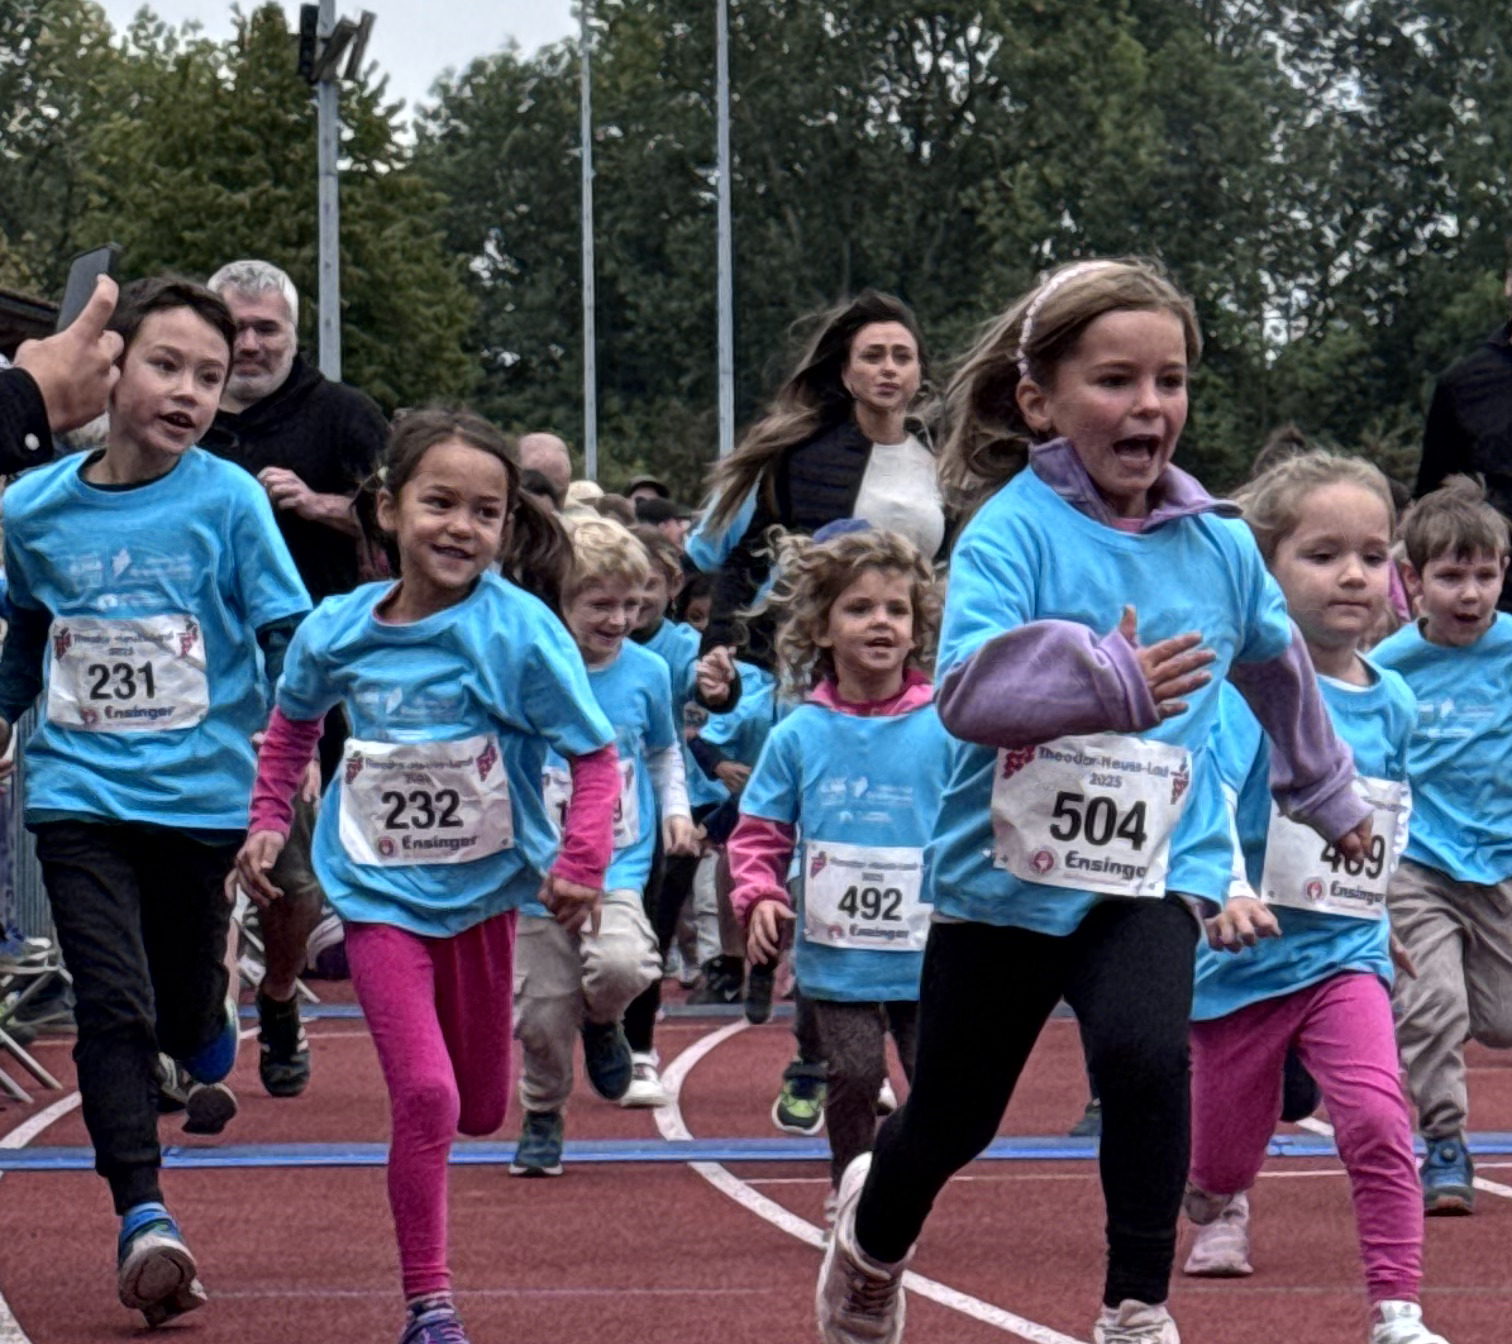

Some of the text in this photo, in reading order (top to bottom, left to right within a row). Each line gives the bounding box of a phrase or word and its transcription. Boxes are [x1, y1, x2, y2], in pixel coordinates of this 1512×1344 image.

[87, 660, 155, 701] 231
[381, 788, 464, 830] 232
[1049, 790, 1148, 851] 504
[402, 834, 478, 851] Ensinger
[1065, 850, 1149, 880] Ensinge
[837, 884, 903, 922] 492
